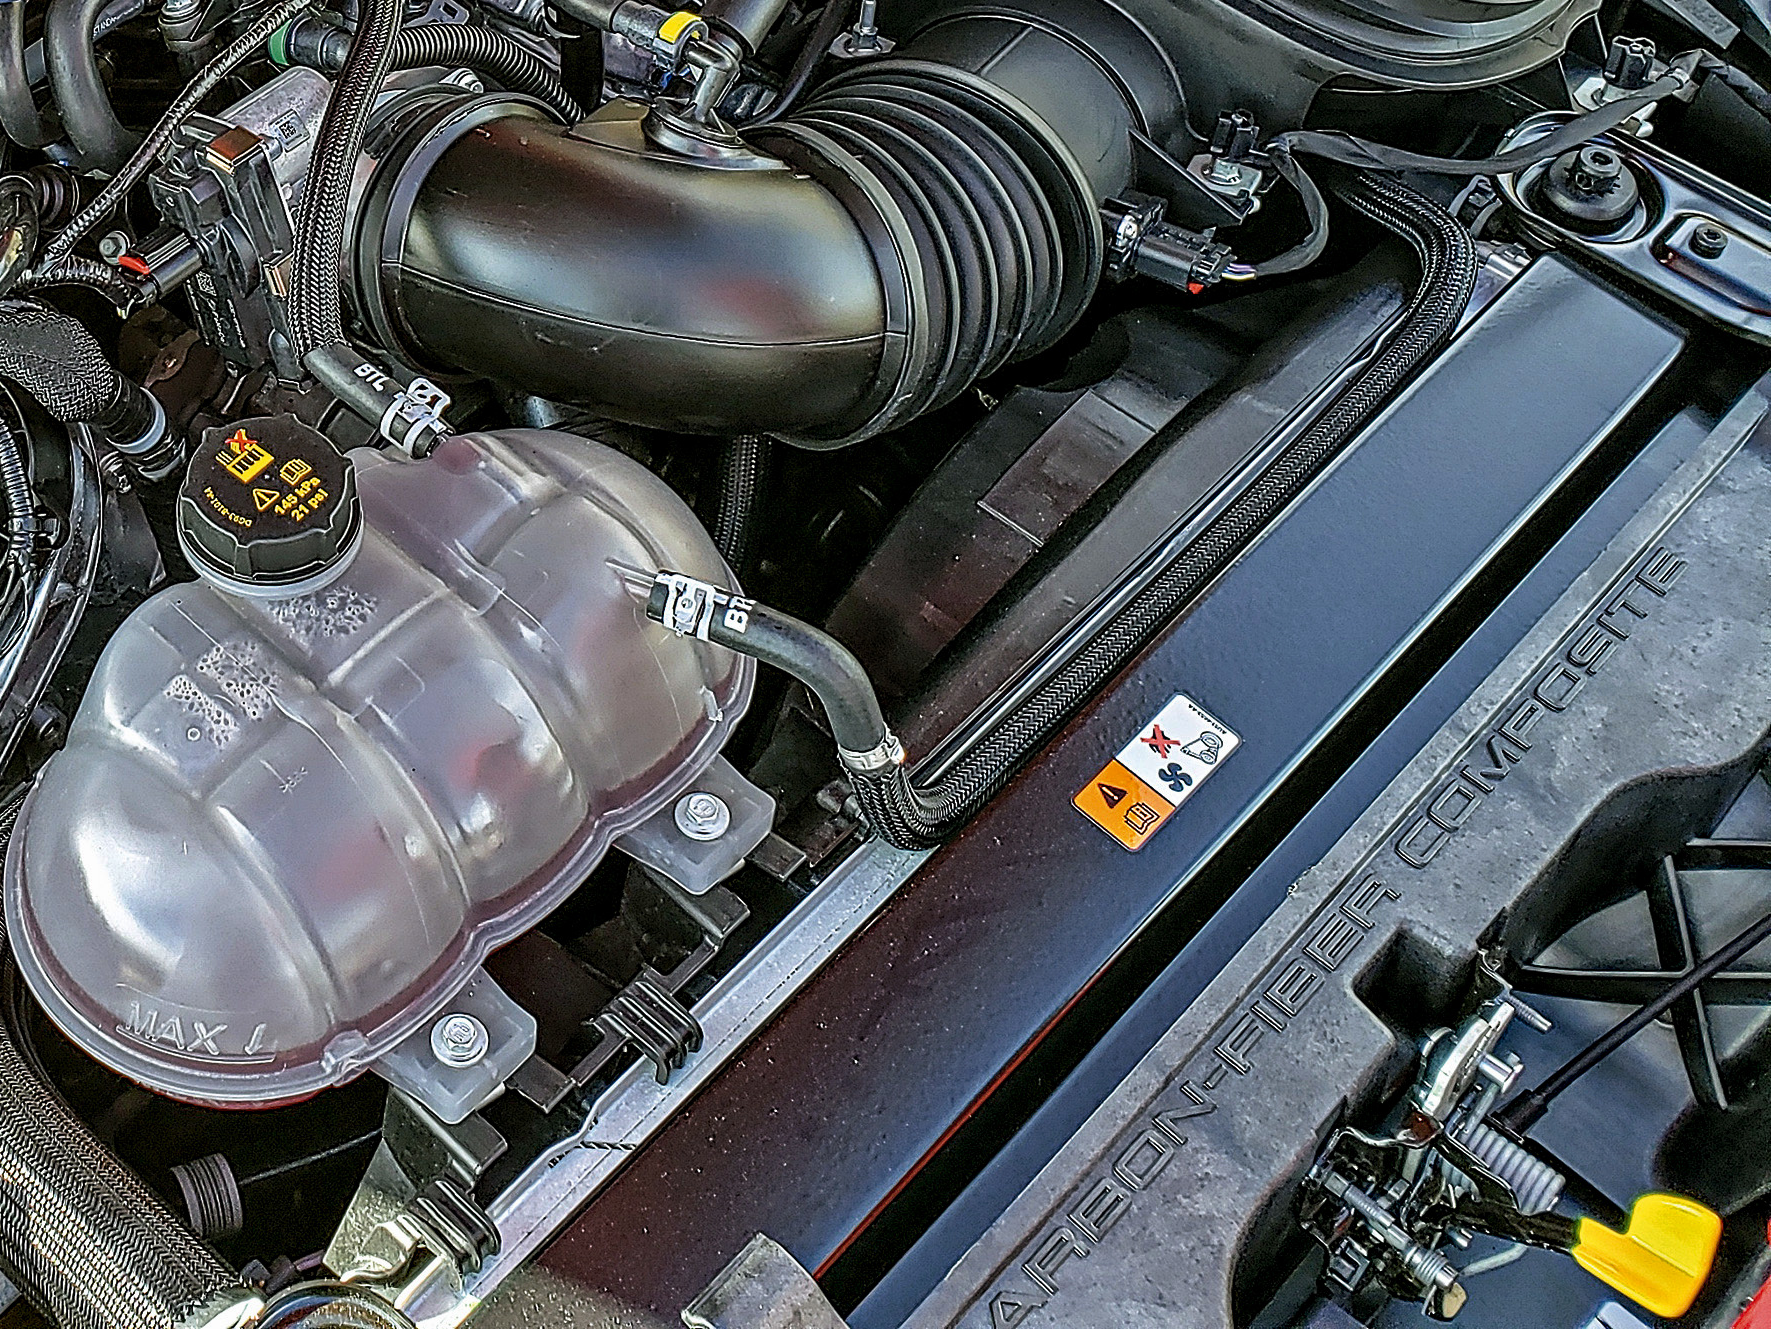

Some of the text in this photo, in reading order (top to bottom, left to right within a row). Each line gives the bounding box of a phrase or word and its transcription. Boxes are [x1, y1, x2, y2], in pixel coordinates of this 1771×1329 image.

[274, 476, 322, 516] 145 kPa
[290, 487, 330, 522] 21 psi
[1393, 545, 1689, 870] COMPOSITE
[114, 1000, 228, 1057] MAX
[989, 873, 1403, 1329] ARBON-FIBER
